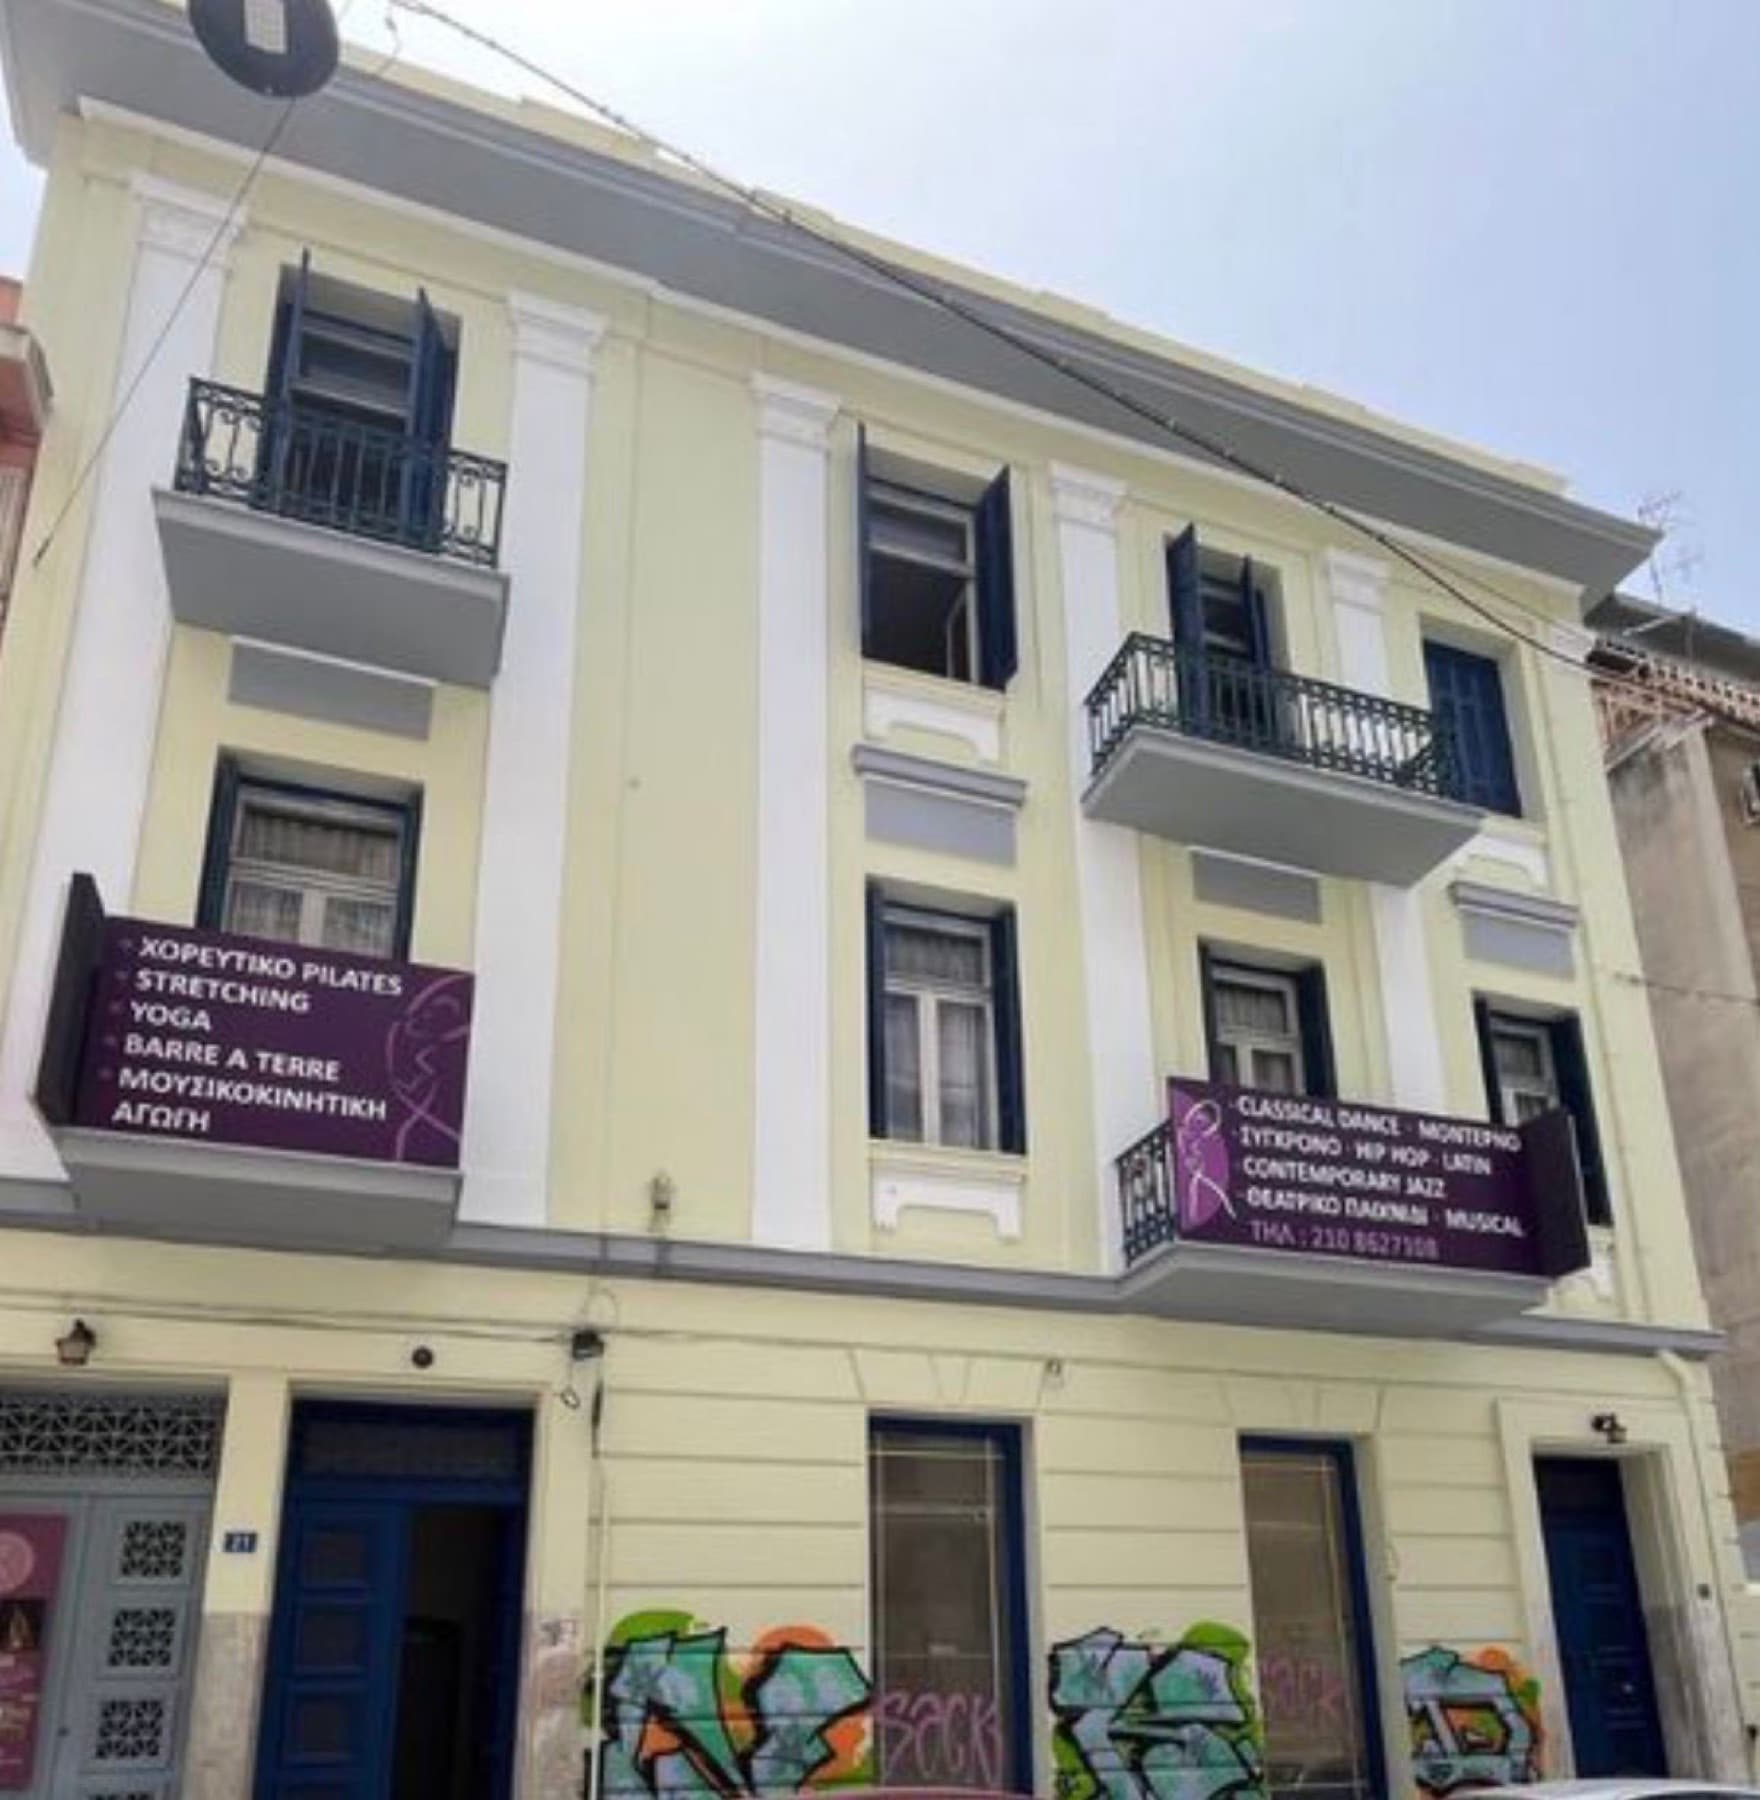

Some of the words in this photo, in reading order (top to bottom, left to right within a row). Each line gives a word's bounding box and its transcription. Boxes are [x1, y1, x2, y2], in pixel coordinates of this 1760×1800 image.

[139, 936, 297, 979] ΧΟΡΕΥΤΙΚΟ
[302, 962, 403, 996] PILATES
[135, 968, 311, 1014] STRETCHING
[130, 1001, 212, 1032] YOGA
[124, 1034, 219, 1066] BARRE
[226, 1050, 249, 1071] A
[257, 1053, 342, 1082] TERRE
[119, 1067, 387, 1121] ΜΟΥΣΙΚΟΚΙΝΗΤΙΚΗ
[112, 1101, 211, 1133] ΑΓΩΓΗ
[1238, 1096, 1335, 1129] CLASSICAL
[1338, 1110, 1400, 1137] DANCE
[1418, 1119, 1522, 1153] ΜΟΝΤΕΡΝΟ
[1243, 1156, 1400, 1191] CONTEMPORARY
[1405, 1175, 1447, 1199] JAZZ
[1355, 1141, 1385, 1161] HIP
[1392, 1146, 1431, 1170] HOP
[1442, 1152, 1492, 1176] LATIN
[1311, 1225, 1350, 1249] 210
[1446, 1208, 1526, 1239] MUSICAL
